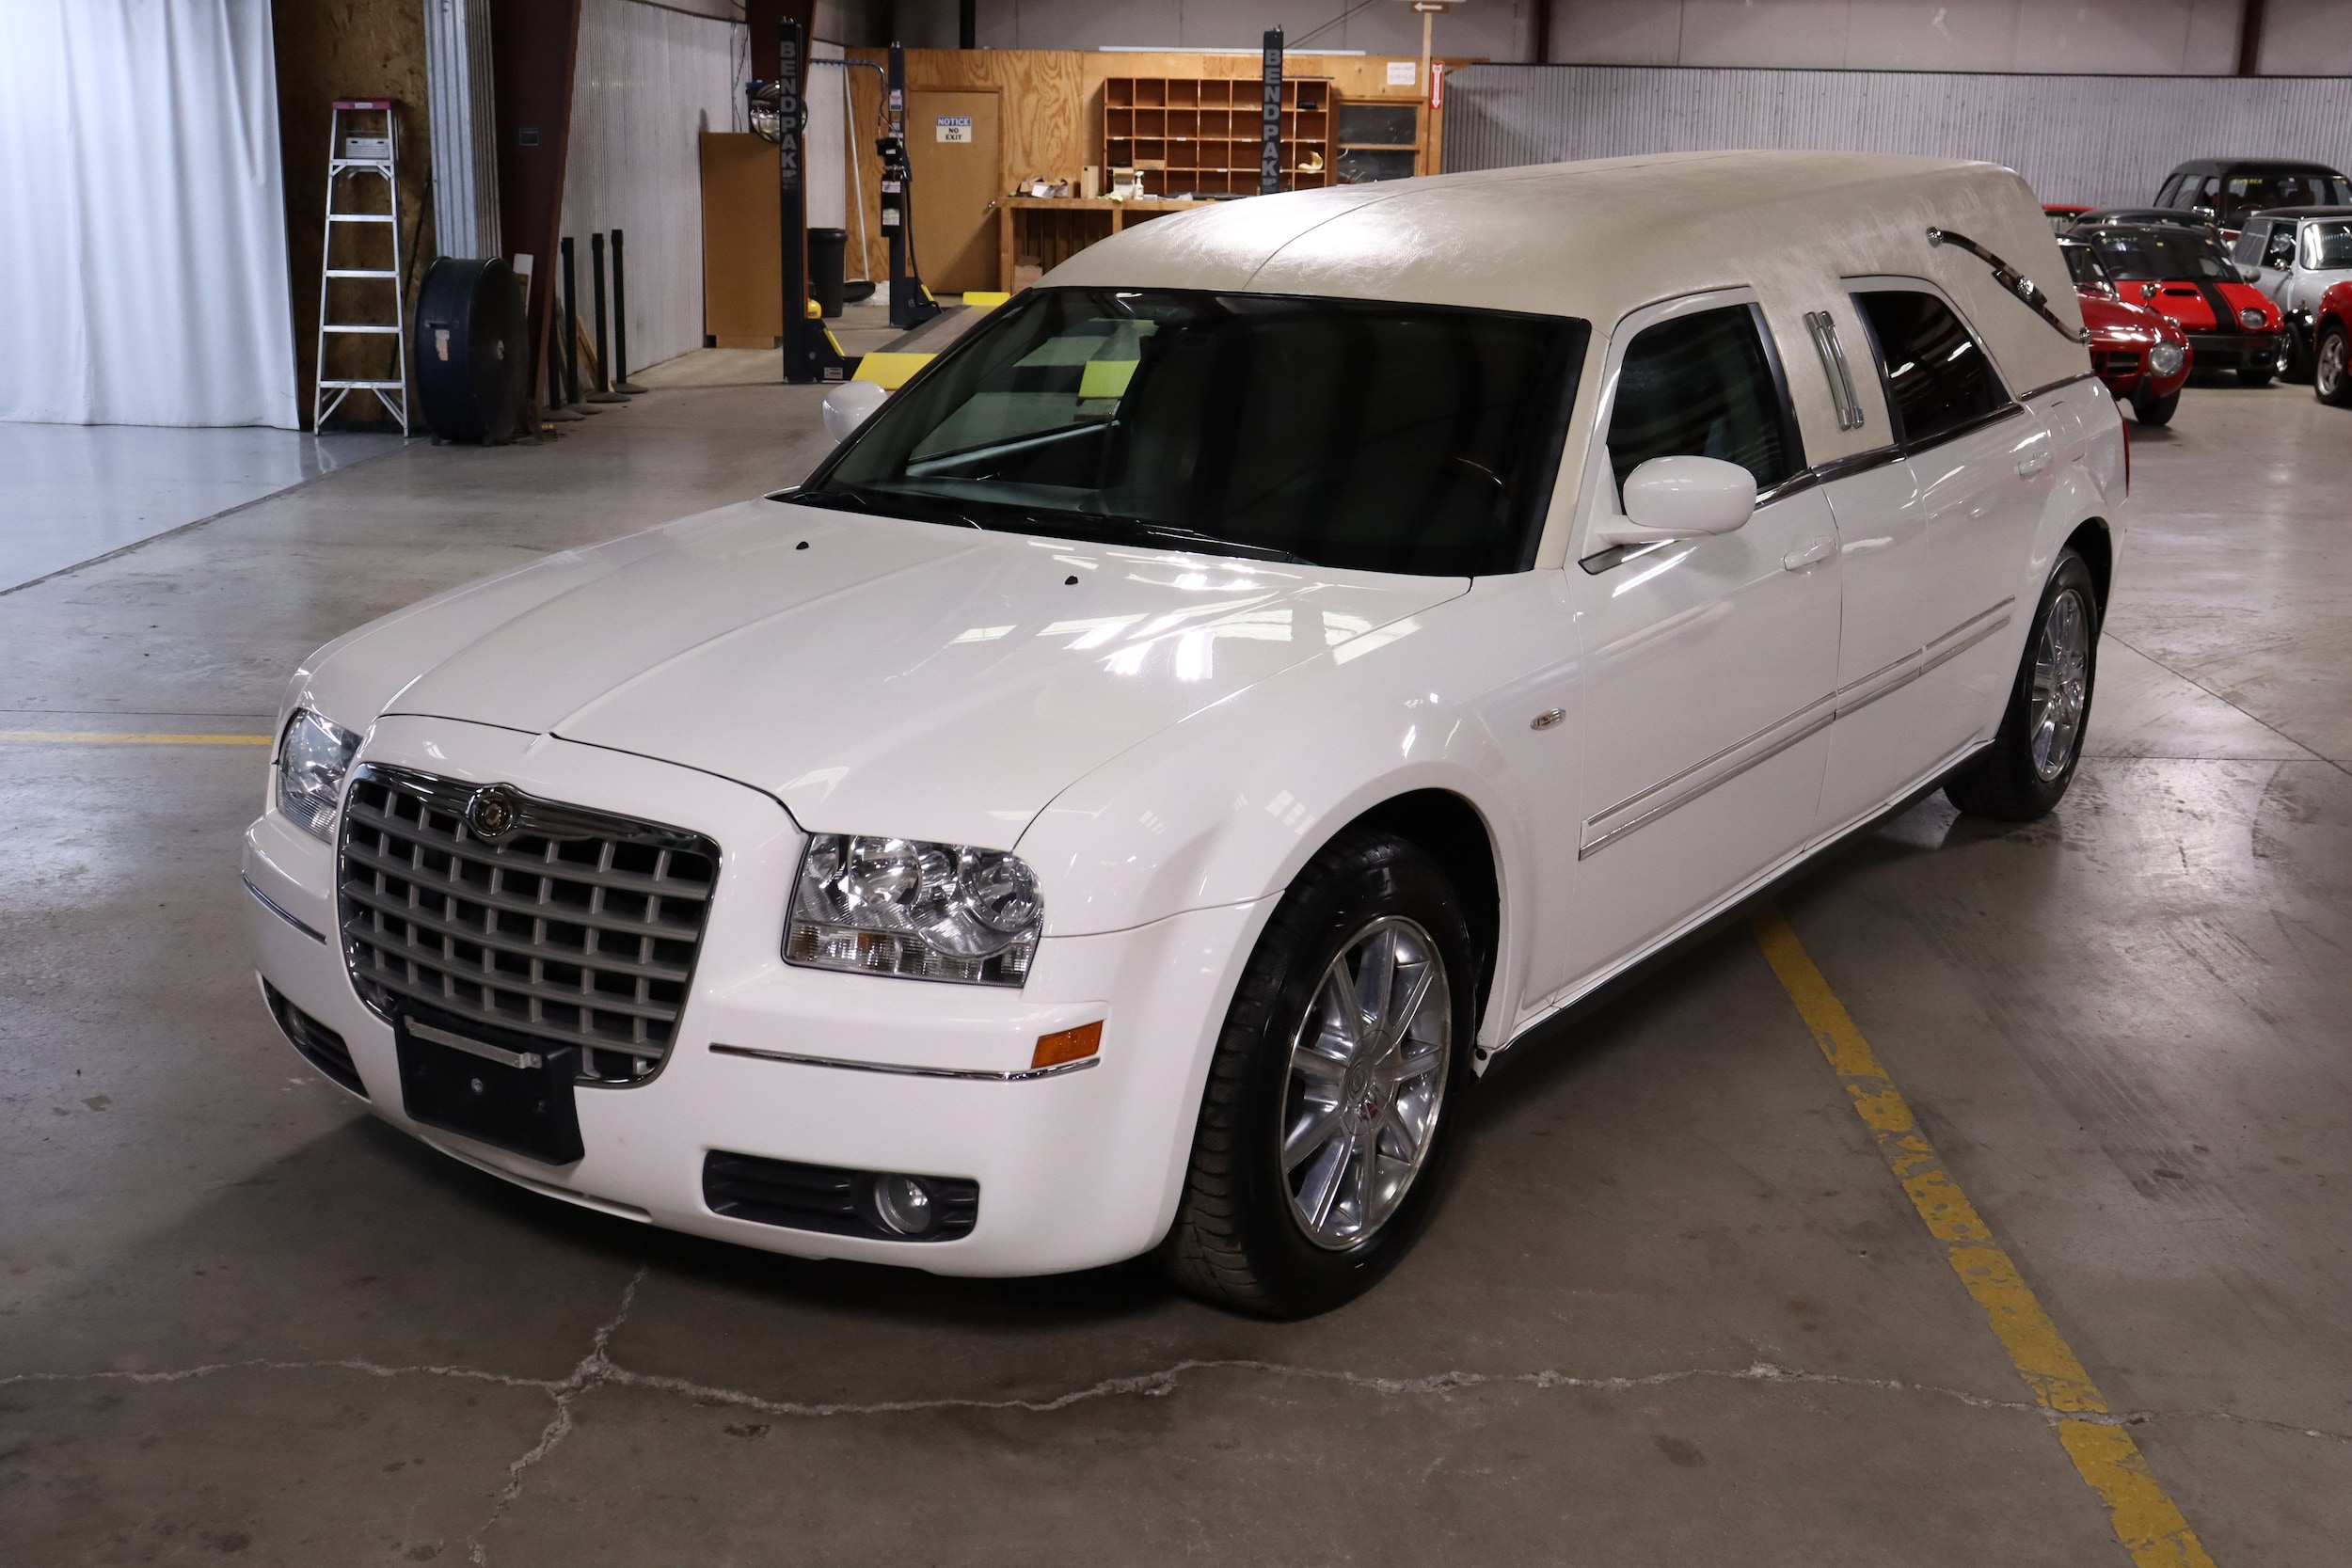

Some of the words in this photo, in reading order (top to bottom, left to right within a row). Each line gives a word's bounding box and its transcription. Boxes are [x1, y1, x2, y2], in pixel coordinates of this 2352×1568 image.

[780, 40, 798, 168] BENDPAK
[937, 118, 970, 126] NOTICE
[1262, 49, 1281, 177] BENDPAK
